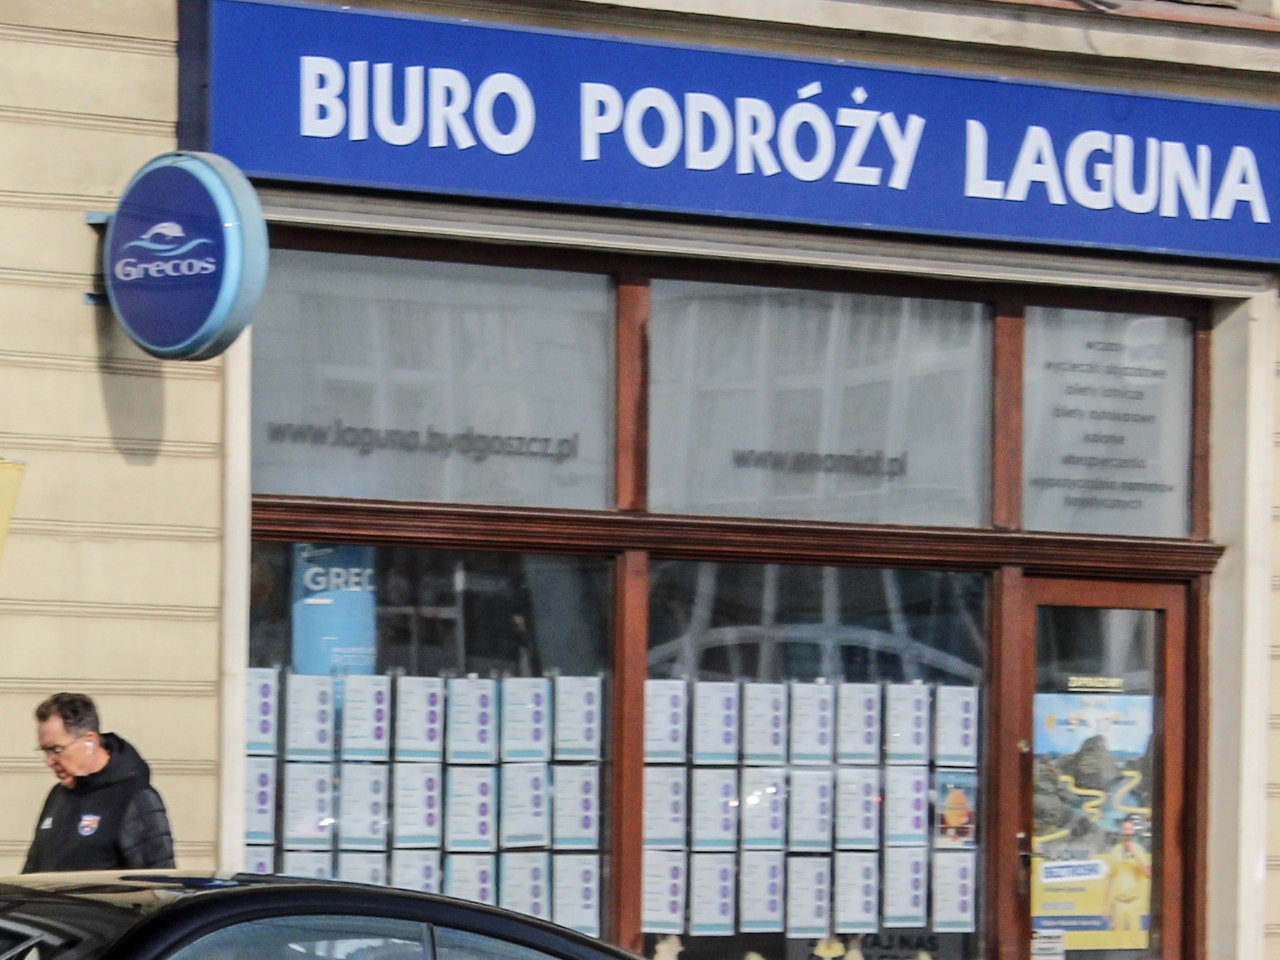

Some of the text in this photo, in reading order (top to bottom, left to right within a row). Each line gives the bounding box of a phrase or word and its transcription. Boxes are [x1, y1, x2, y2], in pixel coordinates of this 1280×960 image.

[300, 55, 1272, 224] BIURO PODRÓŻY LAGUNA
[114, 256, 216, 281] Grecos
